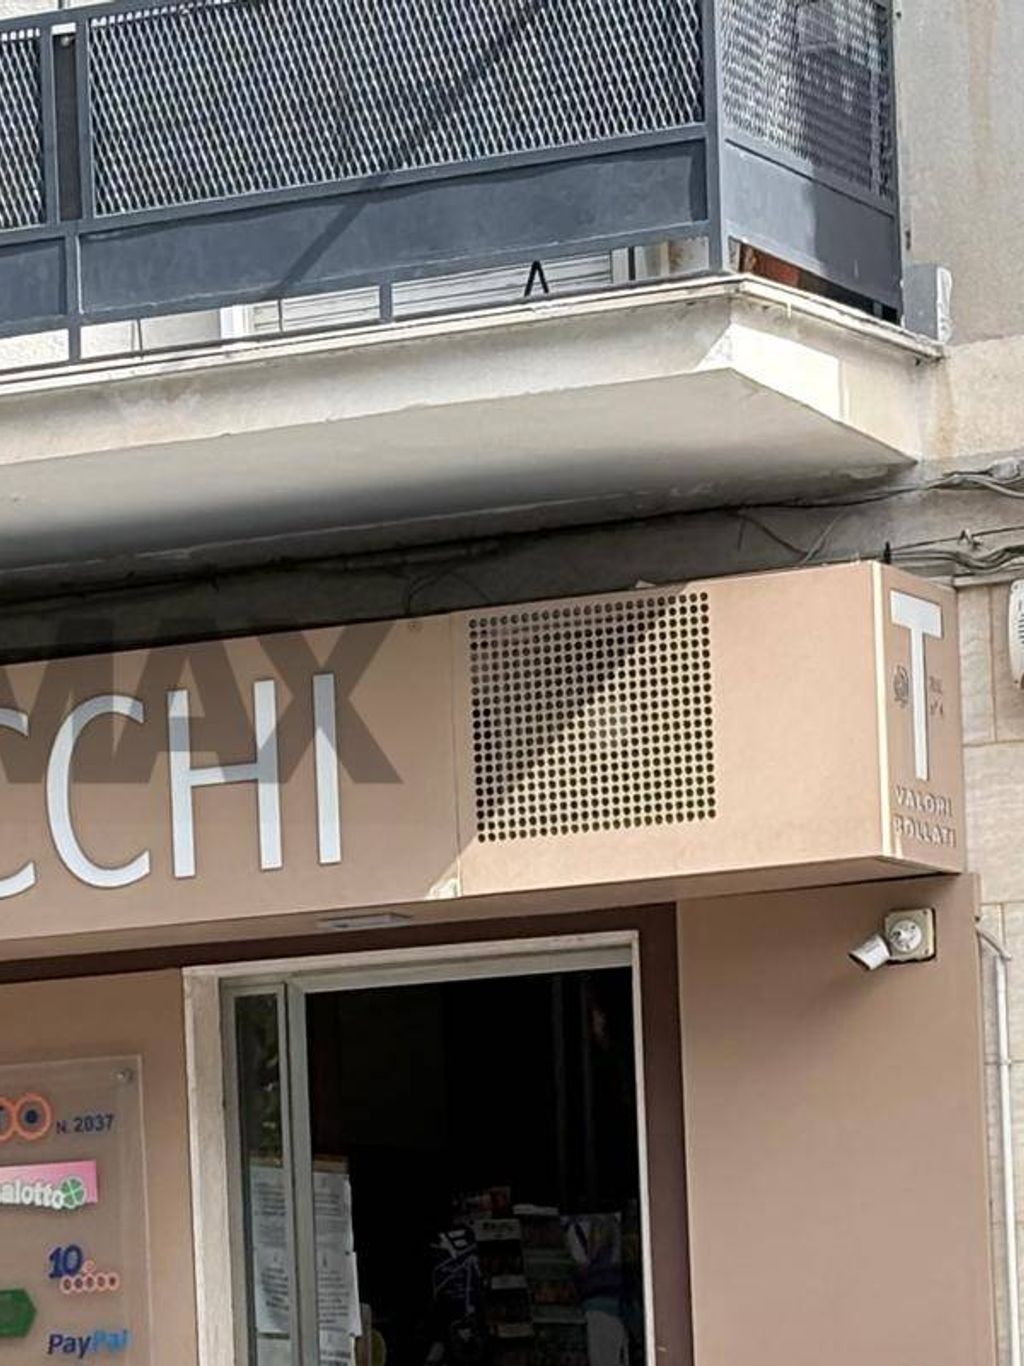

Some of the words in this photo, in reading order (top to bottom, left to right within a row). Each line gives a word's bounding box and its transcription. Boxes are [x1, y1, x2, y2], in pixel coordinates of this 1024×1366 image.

[895, 785, 952, 817] VALORI
[73, 1114, 115, 1134] 2037
[49, 1245, 83, 1279] 10
[47, 1329, 130, 1358] PayPal
